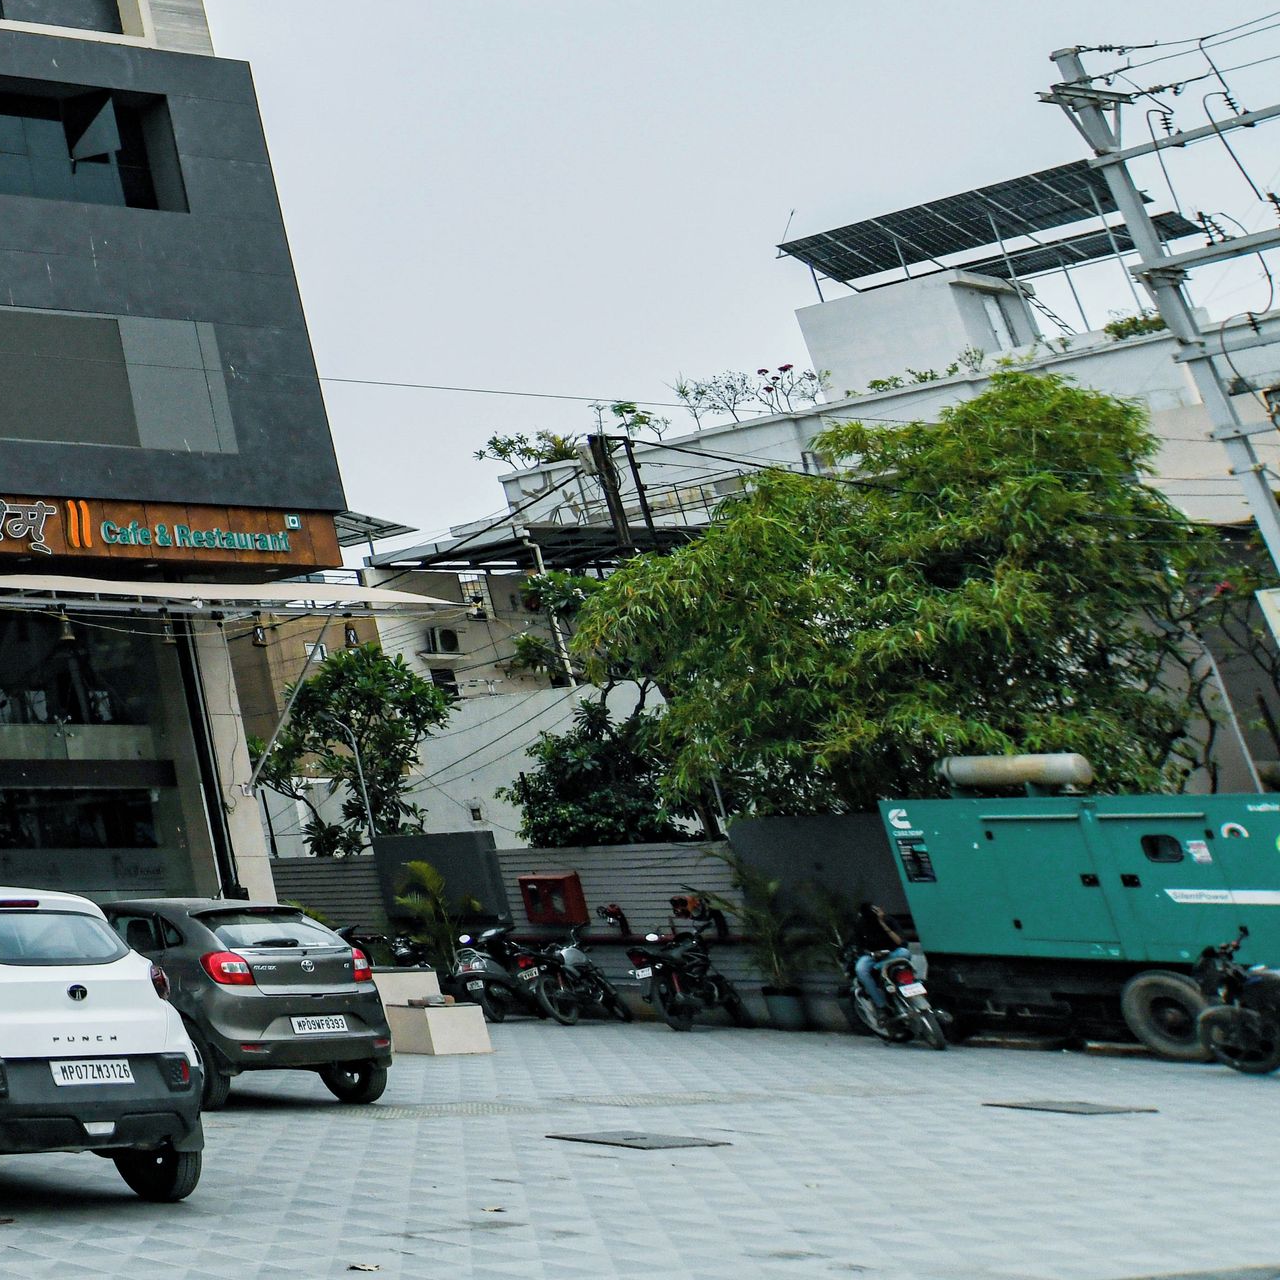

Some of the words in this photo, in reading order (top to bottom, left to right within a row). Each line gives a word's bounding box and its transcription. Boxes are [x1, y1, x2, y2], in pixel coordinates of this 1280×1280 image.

[100, 520, 151, 545] Cafe
[155, 523, 171, 547] &
[174, 524, 291, 552] Restaurant
[297, 1018, 345, 1031] MP09WF8393
[53, 1035, 118, 1043] PUNCH
[60, 1063, 131, 1081] MP07ZM3126
